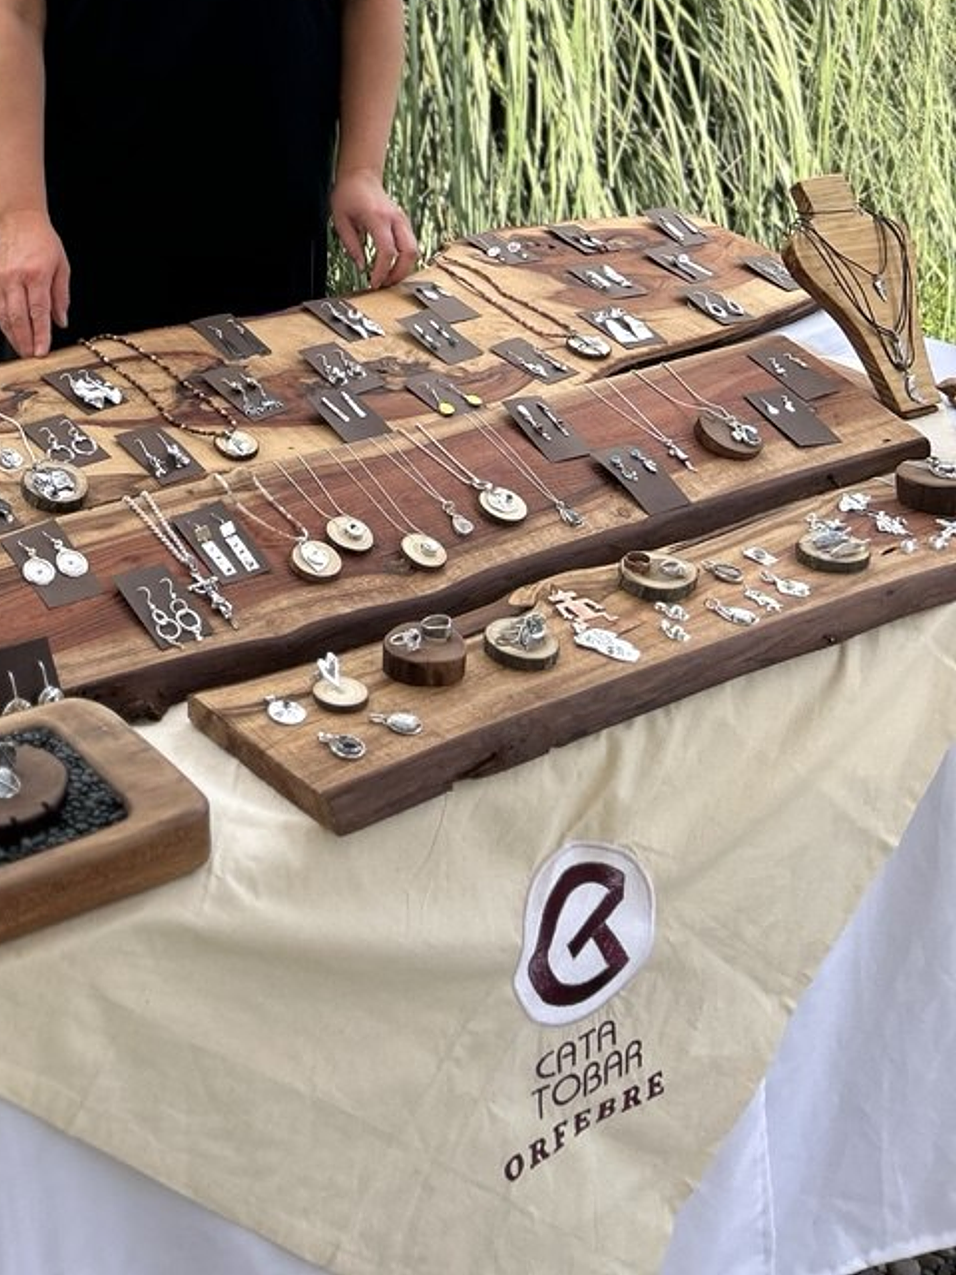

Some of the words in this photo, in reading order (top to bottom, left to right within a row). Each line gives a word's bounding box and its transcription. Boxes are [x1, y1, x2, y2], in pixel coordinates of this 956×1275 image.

[532, 1040, 643, 1119] TOBAR
[535, 1020, 617, 1079] CATA
[504, 1071, 665, 1182] ORFEBRE
